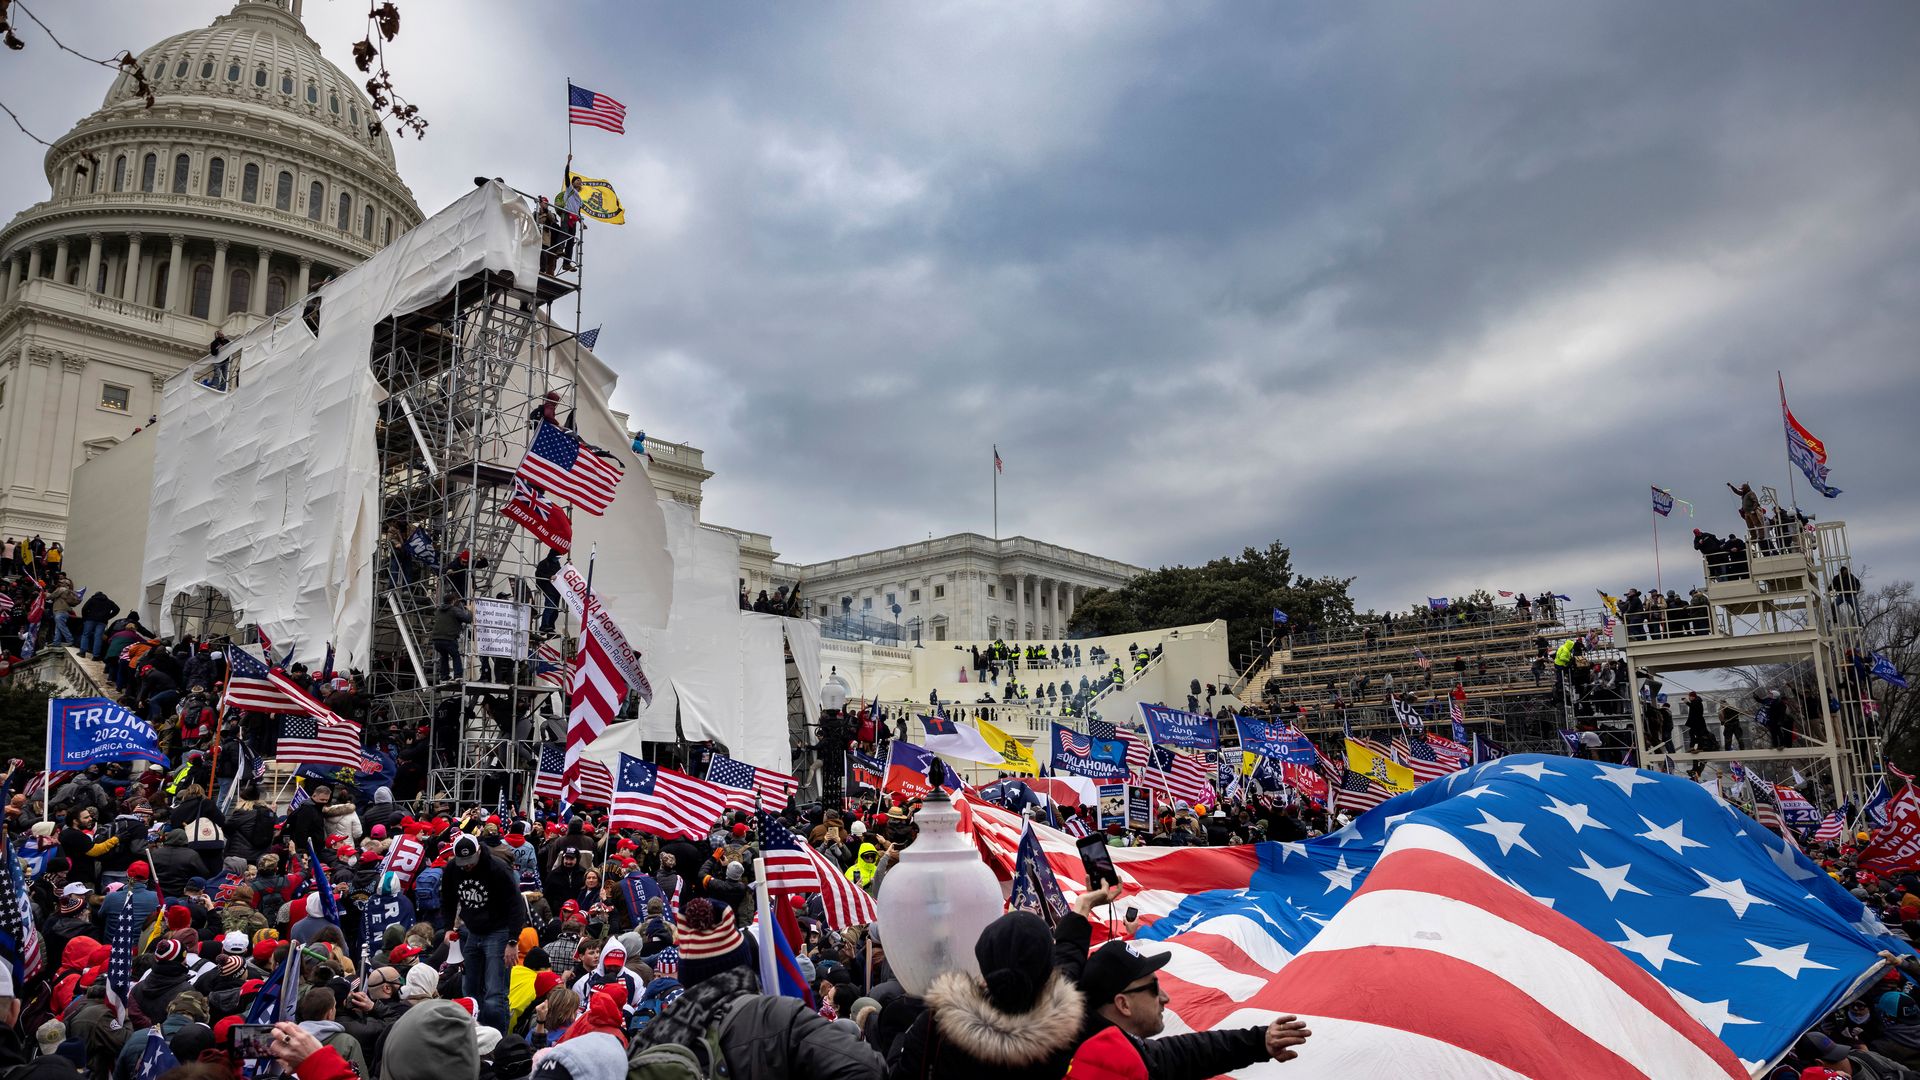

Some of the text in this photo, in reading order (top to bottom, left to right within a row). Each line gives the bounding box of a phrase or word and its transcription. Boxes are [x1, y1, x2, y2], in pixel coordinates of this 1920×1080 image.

[507, 503, 537, 525] LIBERTY
[537, 524, 549, 537] AND
[565, 590, 642, 692] Chines American Republicans
[596, 611, 622, 642] FIGHT
[618, 641, 635, 668] FOR
[69, 707, 159, 741] TRUMP
[1150, 709, 1209, 727] TRUMP
[67, 750, 91, 759] KEEP
[1063, 752, 1119, 773] OKLAHOMA
[1065, 764, 1113, 777] FOR TRUMP
[902, 780, 914, 789] I'm
[1796, 809, 1820, 822] 20
[633, 879, 647, 901] KEEP
